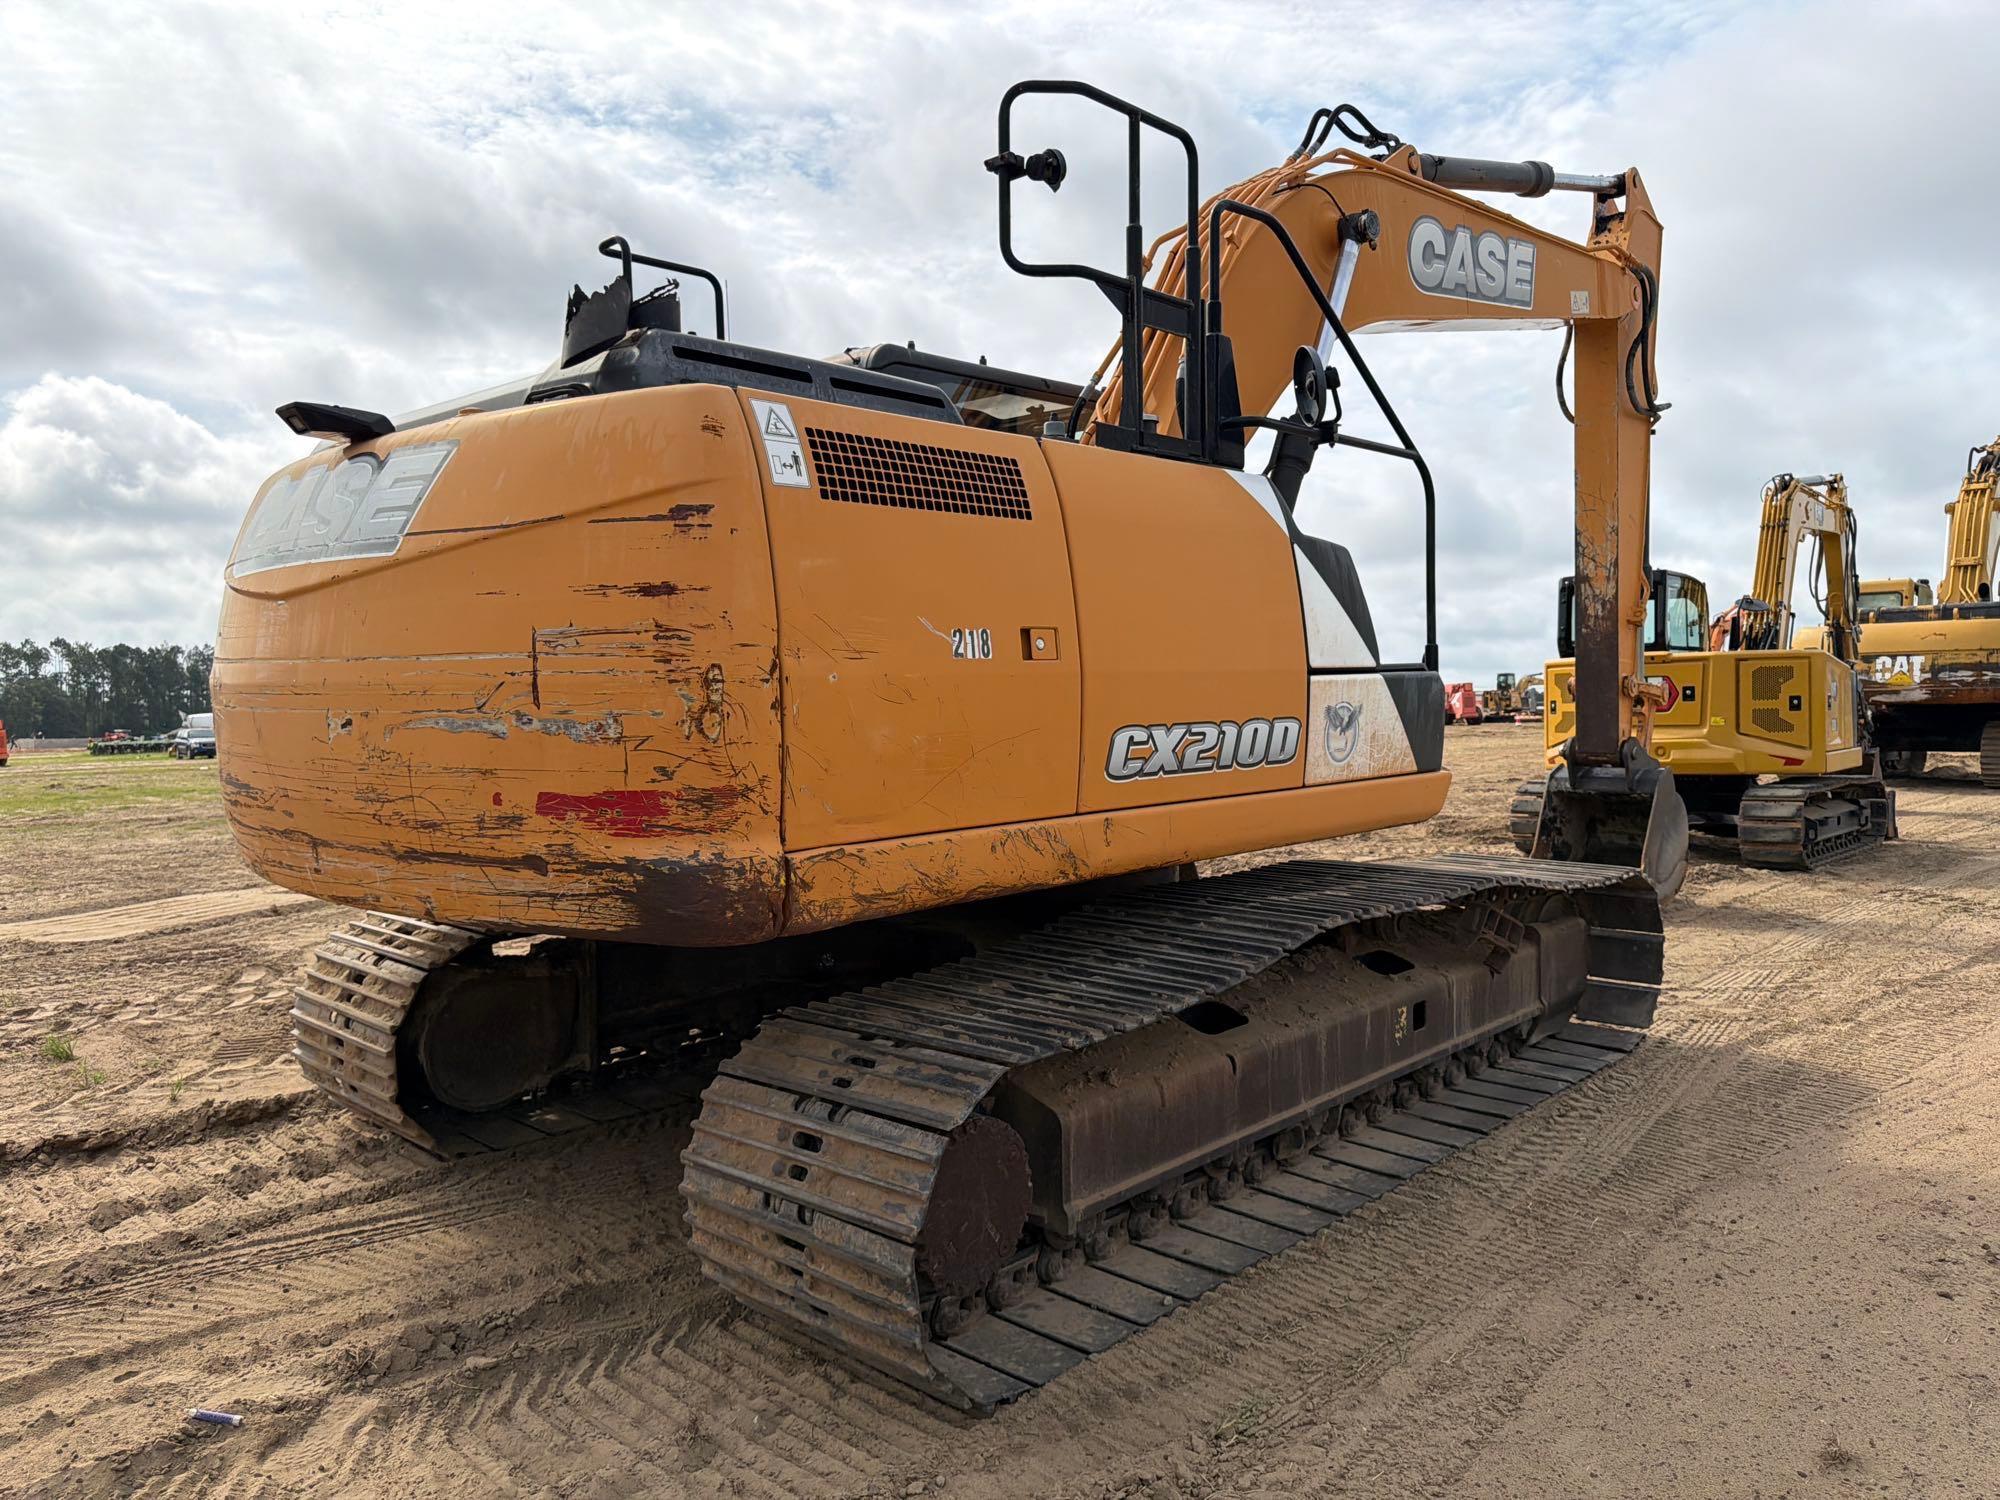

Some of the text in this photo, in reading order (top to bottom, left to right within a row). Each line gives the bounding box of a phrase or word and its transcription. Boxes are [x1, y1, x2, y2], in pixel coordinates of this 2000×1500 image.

[1409, 217, 1533, 302] CASE
[951, 628, 991, 659] 218
[1875, 655, 1925, 684] CAT
[1105, 717, 1302, 781] CX210D
